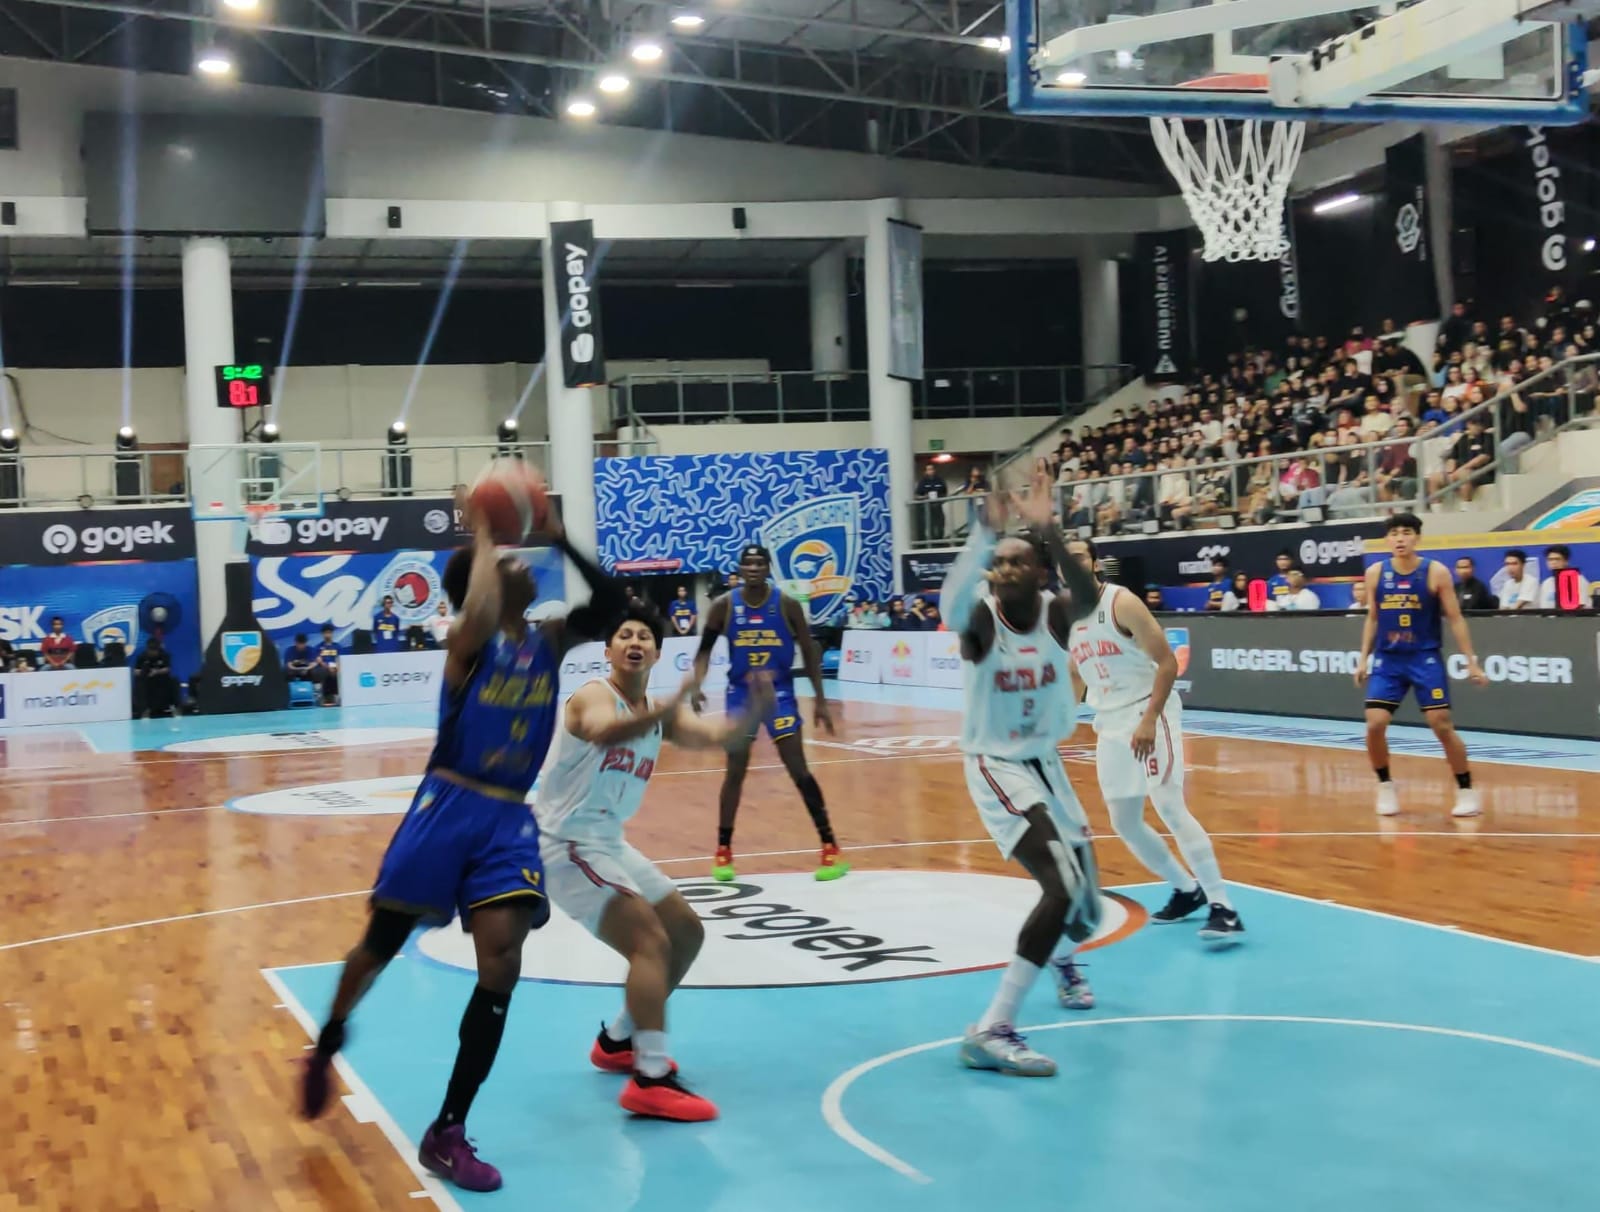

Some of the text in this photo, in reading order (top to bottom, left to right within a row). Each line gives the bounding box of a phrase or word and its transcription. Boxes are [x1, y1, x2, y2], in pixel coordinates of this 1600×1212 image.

[565, 242, 592, 328] gopay
[81, 520, 176, 554] gojek
[297, 515, 390, 544] gopay
[748, 652, 771, 666] 27
[1447, 654, 1573, 683] COSER
[220, 674, 265, 687] gopay
[381, 668, 433, 687] gopay
[774, 716, 795, 730] 27
[701, 903, 942, 972] gojek
